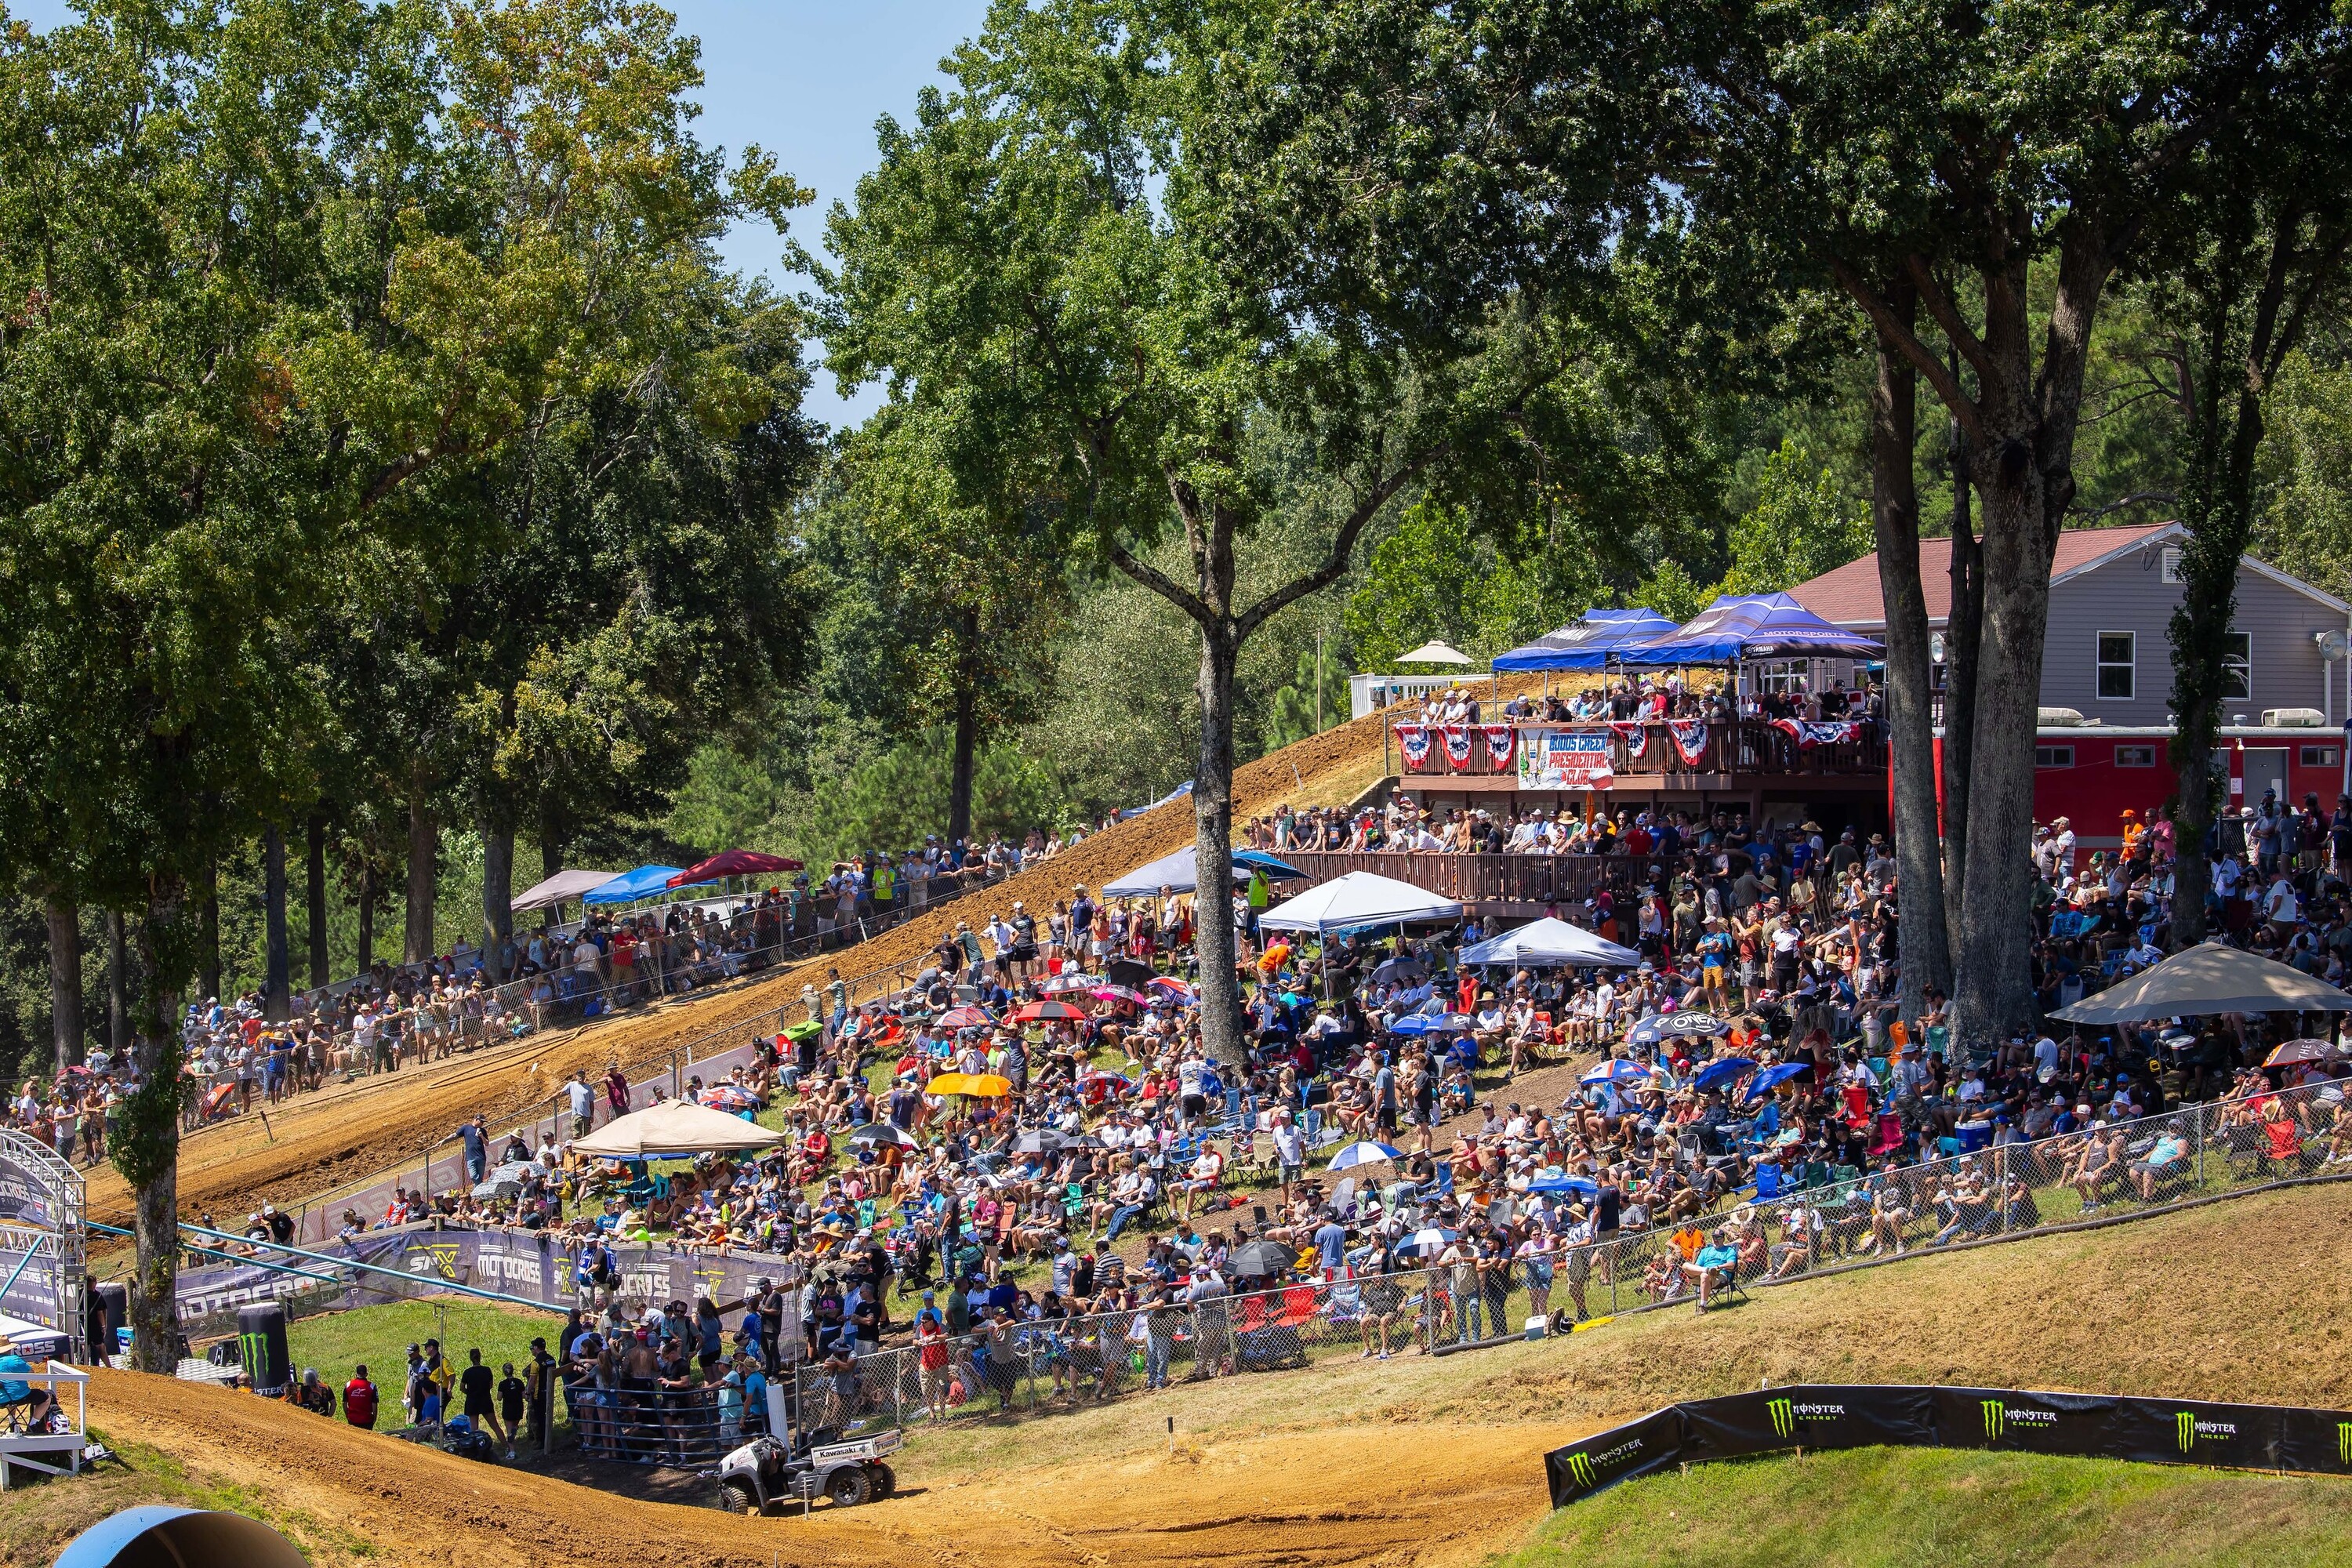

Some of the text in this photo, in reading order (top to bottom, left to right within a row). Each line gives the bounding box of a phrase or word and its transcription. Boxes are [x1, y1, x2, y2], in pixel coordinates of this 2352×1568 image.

[1548, 734, 1608, 752] BUDDS CREEK
[1548, 752, 1609, 768] PRESIDENTIAL
[1566, 769, 1591, 785] CLUB
[477, 1254, 541, 1285] MOTOCROSS
[619, 1262, 638, 1272] PRO
[692, 1277, 722, 1308] SMX
[2005, 1408, 2058, 1421] MONSTER
[2194, 1421, 2237, 1434] MONSTER
[819, 1446, 857, 1458] Kawasaki
[1590, 1437, 1644, 1465] MONSTER
[1602, 1450, 1639, 1467] ENERGY
